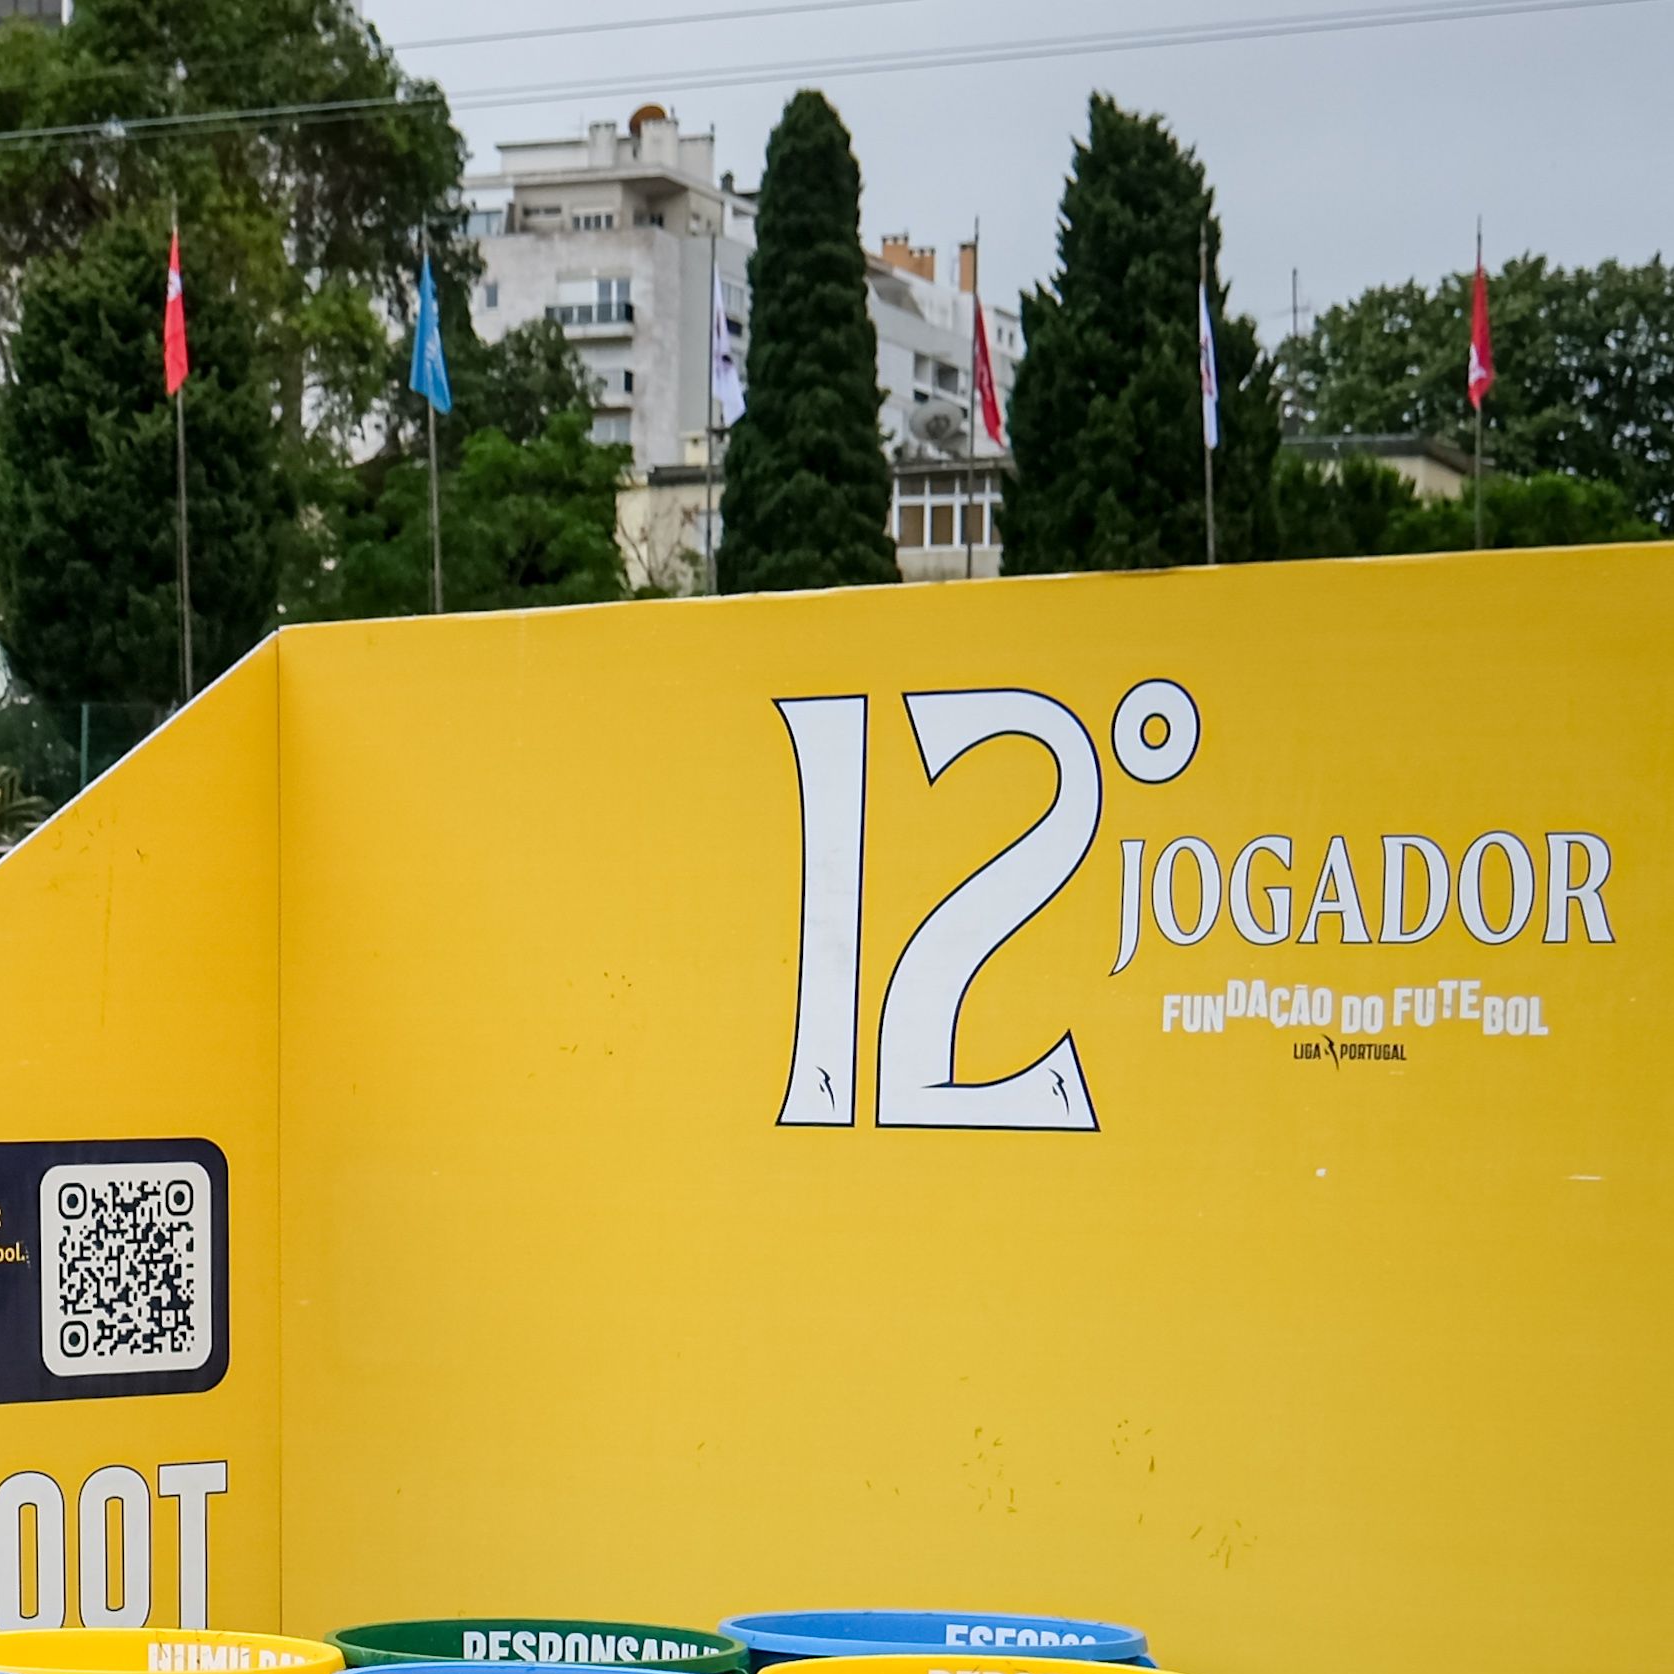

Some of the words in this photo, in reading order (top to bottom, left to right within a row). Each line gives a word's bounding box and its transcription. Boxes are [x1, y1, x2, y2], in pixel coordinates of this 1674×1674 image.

[1108, 831, 1617, 977] JOGADOR
[1162, 979, 1333, 1033] FUNDAÇÃO
[1340, 996, 1384, 1035] DO
[1392, 979, 1550, 1036] FUTEBOL
[1293, 1042, 1322, 1061] LIGA
[1339, 1042, 1408, 1062] PORTUGAL
